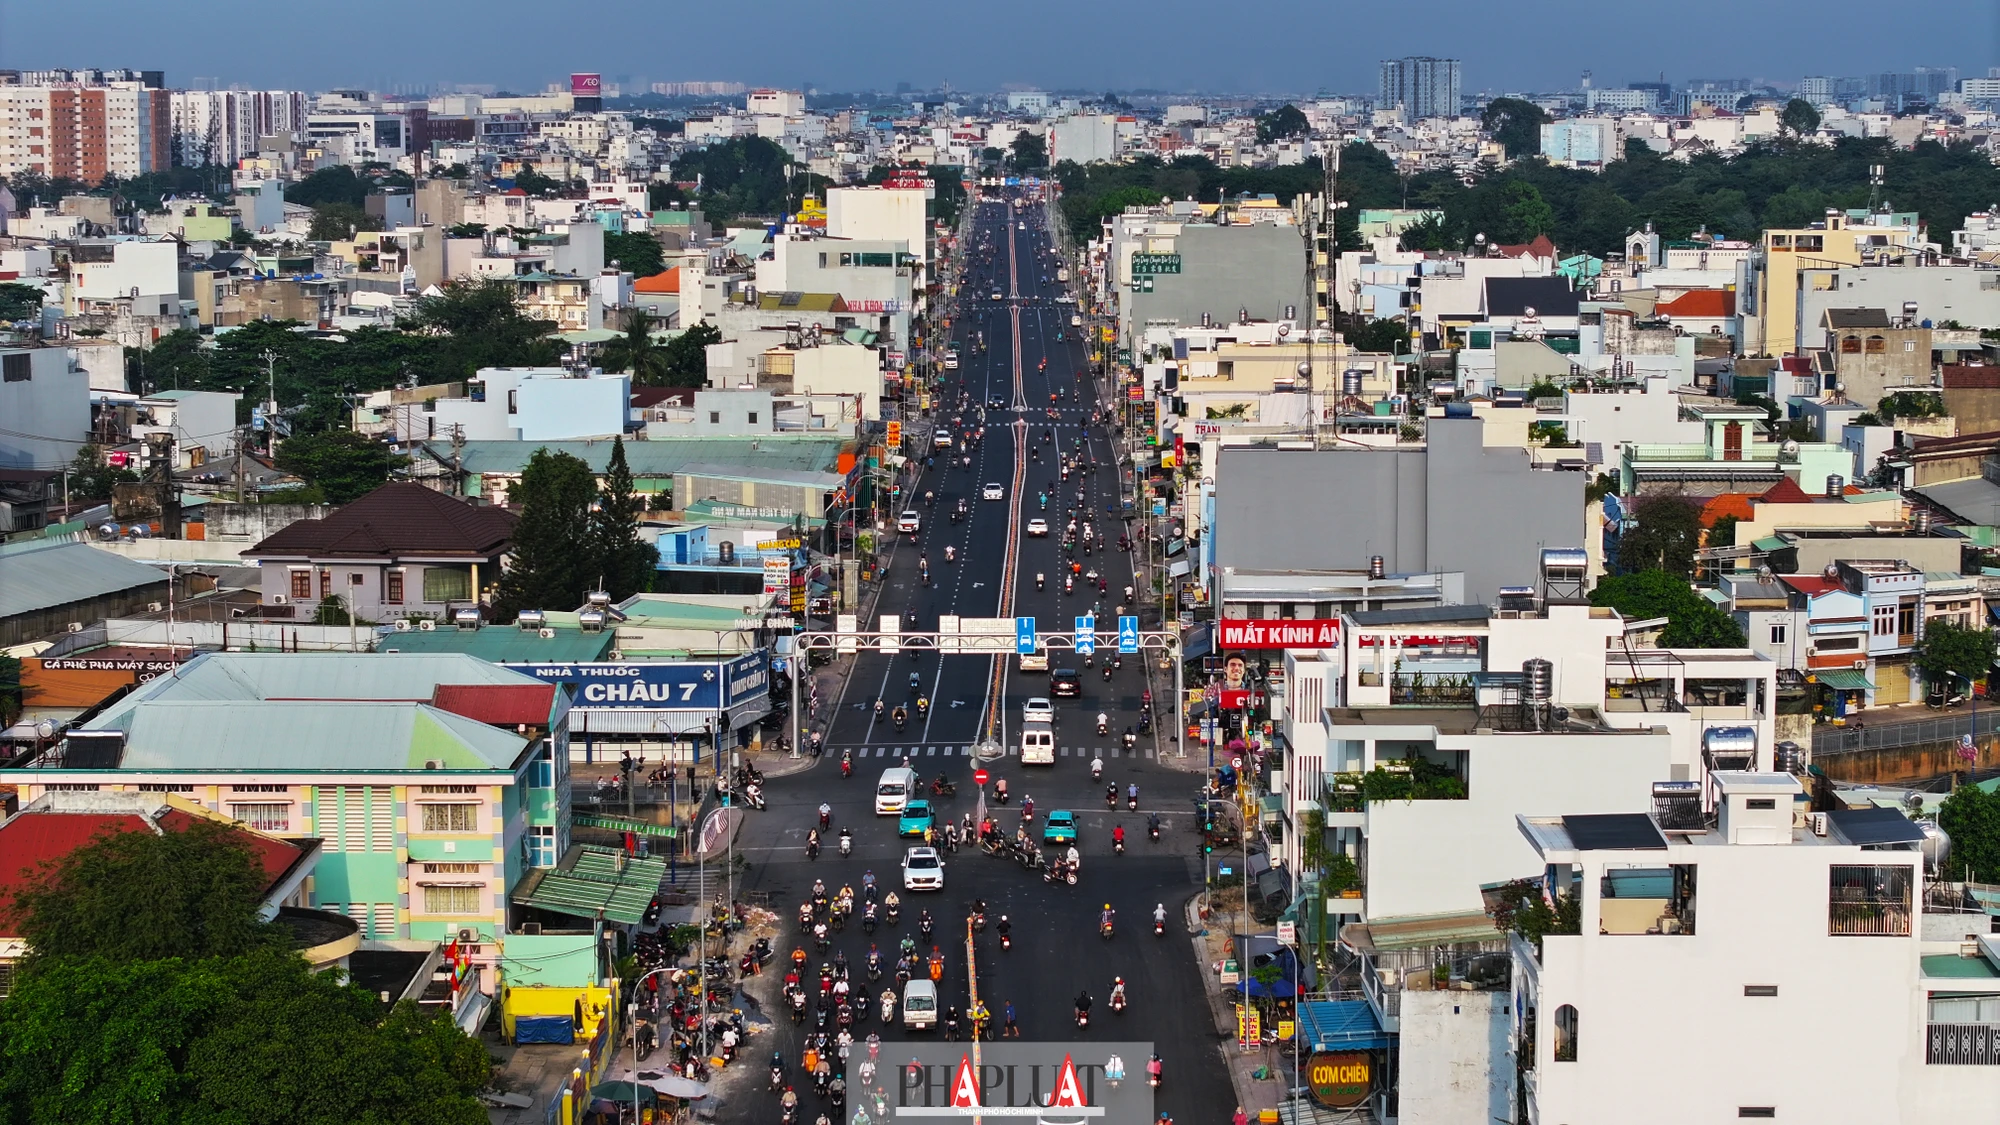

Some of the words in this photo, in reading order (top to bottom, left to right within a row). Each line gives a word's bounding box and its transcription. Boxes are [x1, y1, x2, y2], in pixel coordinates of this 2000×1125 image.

[735, 619, 762, 629] MINH
[767, 616, 794, 628] CHÂU
[1226, 622, 1265, 644] MẮT
[1269, 624, 1313, 643] KÍNH
[89, 662, 114, 670] PHA
[117, 660, 145, 670] MÁY
[536, 667, 572, 676] NHÀ
[579, 665, 640, 676] THUỐC
[584, 680, 669, 701] CHÂU
[679, 683, 698, 701] 7
[1313, 1065, 1338, 1084] CƠM
[1340, 1062, 1369, 1083] CHIÊN
